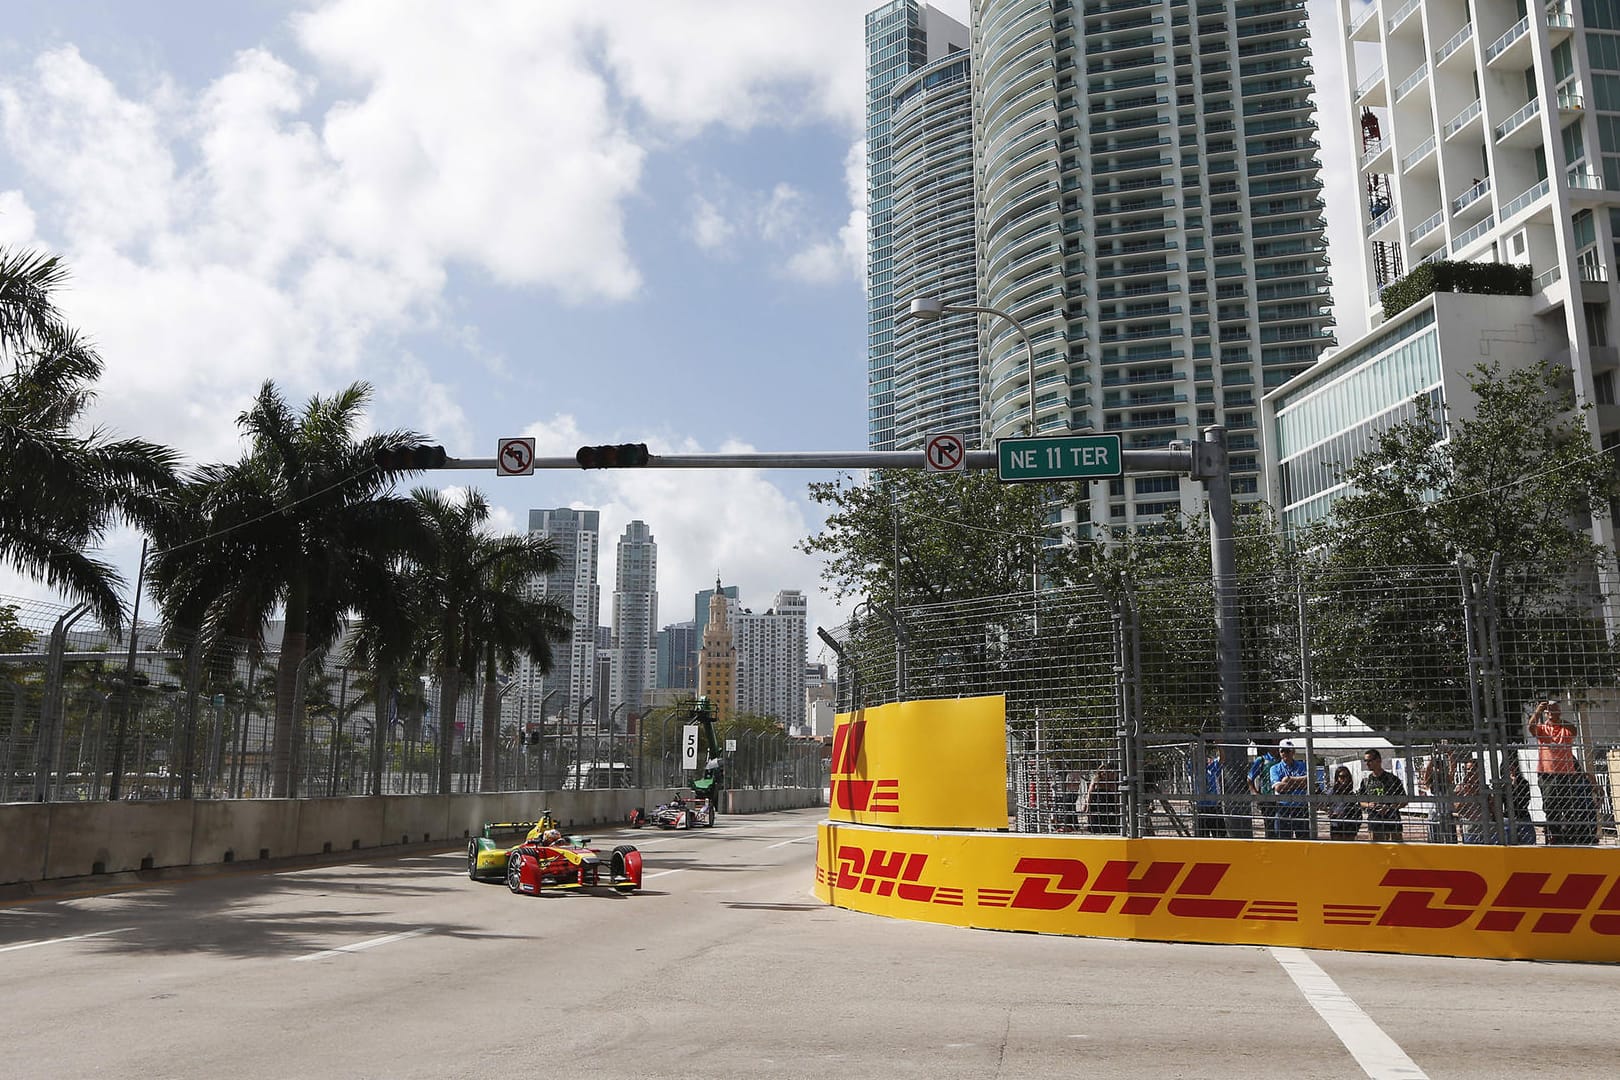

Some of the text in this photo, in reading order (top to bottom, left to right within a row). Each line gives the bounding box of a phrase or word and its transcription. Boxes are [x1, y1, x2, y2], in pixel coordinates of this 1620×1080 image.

[1010, 446, 1109, 469] NE 11 TER
[686, 734, 696, 758] 50
[836, 846, 936, 903] DHL
[1011, 857, 1248, 919] DHL
